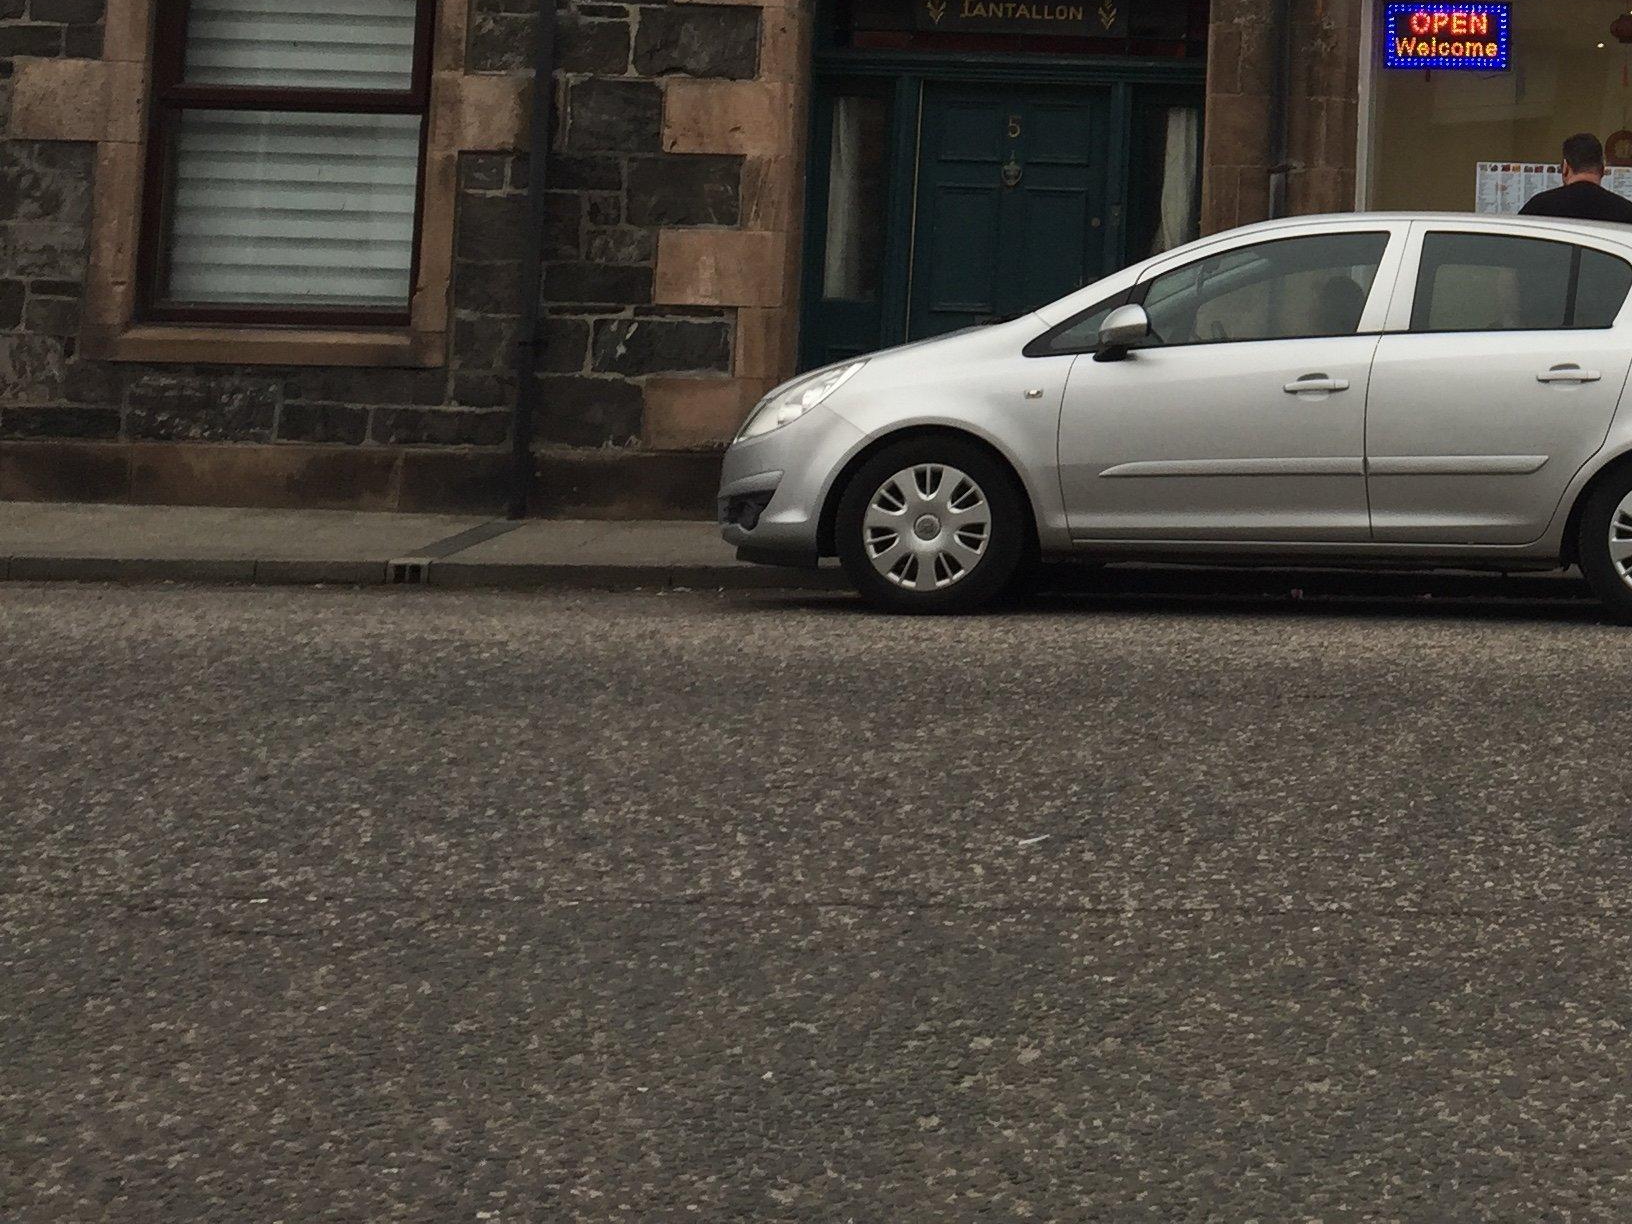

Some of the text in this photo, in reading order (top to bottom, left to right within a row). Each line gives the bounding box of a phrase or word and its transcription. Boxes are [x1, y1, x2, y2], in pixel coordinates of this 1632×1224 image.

[1410, 10, 1488, 35] OPEN
[1395, 36, 1499, 58] Welcome
[1007, 115, 1021, 138] 5
